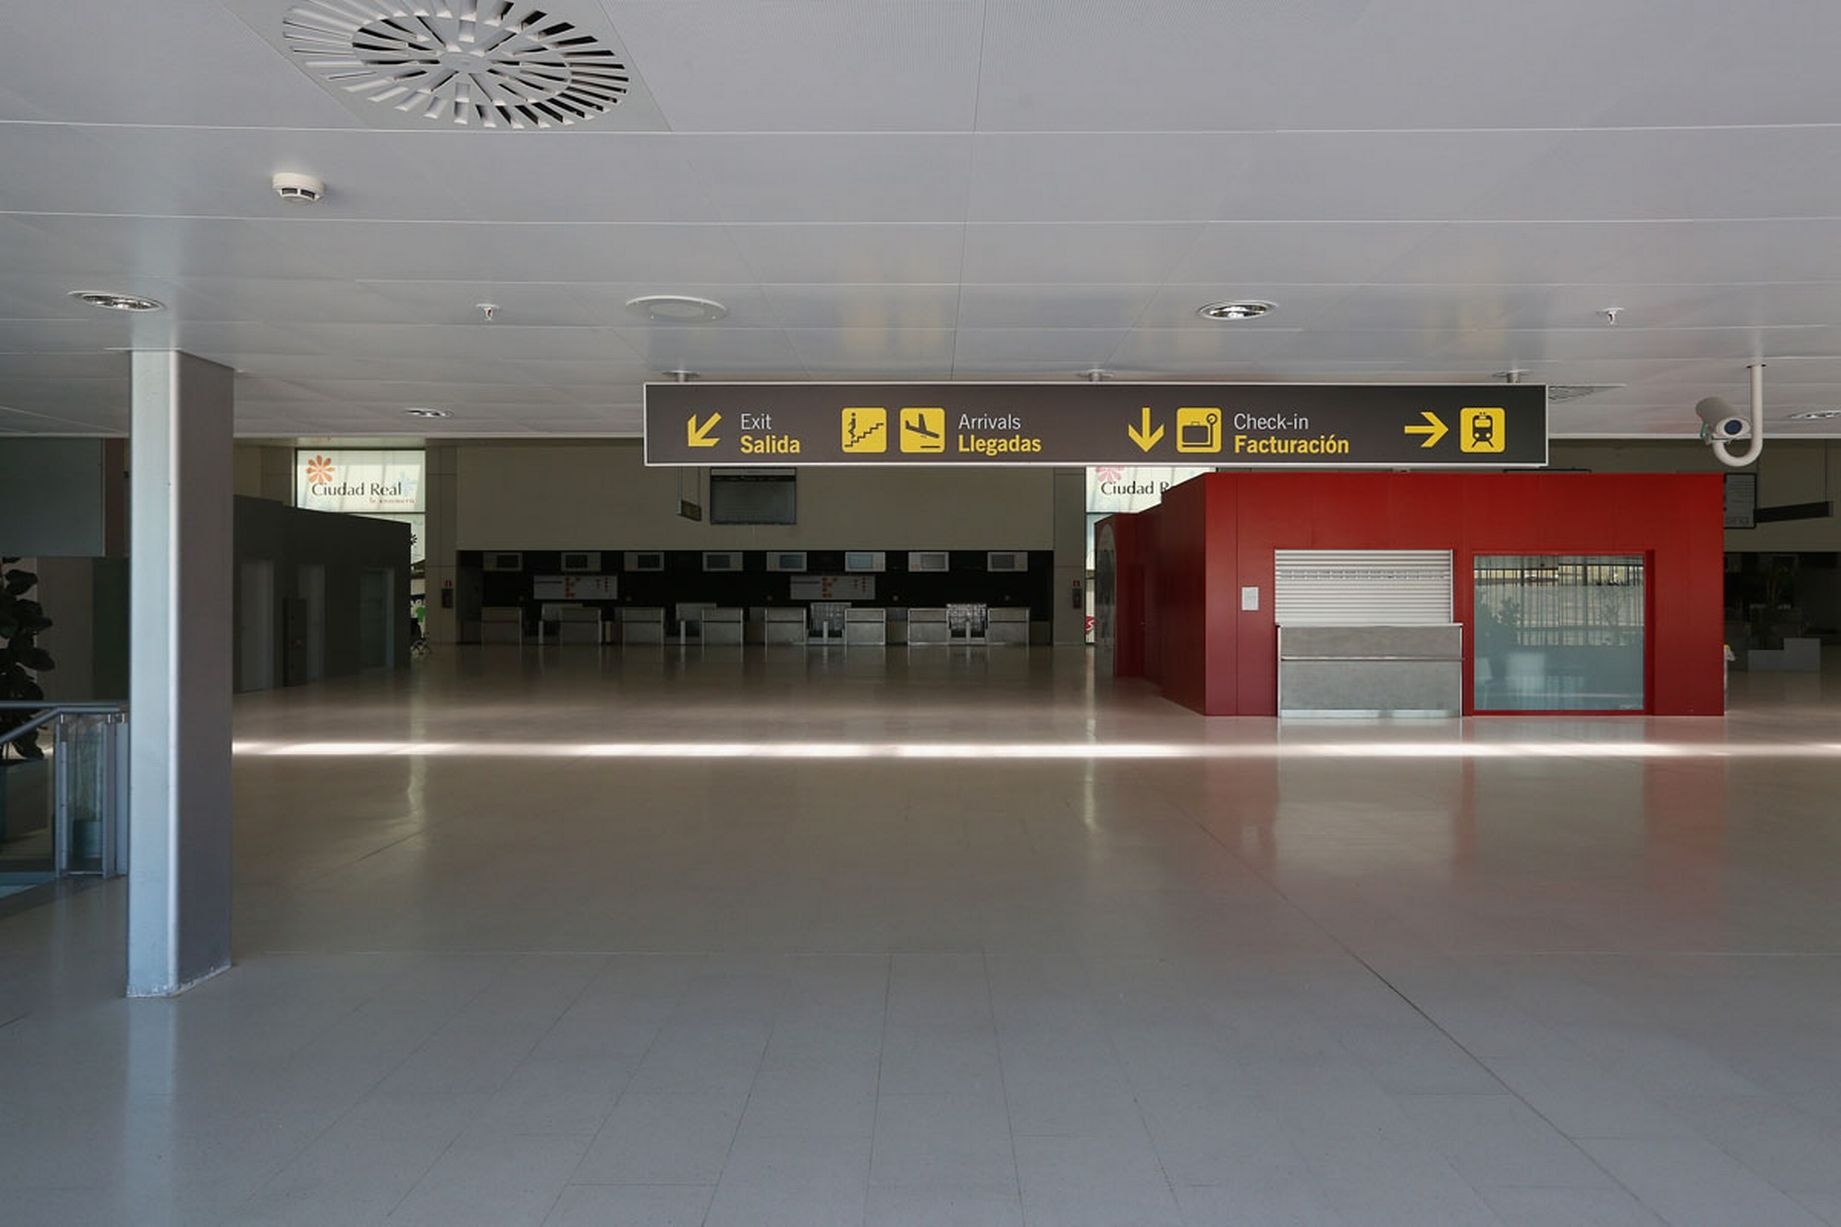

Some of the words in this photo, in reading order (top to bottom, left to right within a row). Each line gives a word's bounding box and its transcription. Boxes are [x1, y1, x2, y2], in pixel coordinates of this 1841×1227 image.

[740, 413, 772, 430] Exit
[958, 413, 1021, 430] Arrivals
[1233, 412, 1309, 430] Check-in
[740, 434, 801, 454] Salida
[958, 434, 1042, 457] Llegadas
[1233, 434, 1349, 454] Facturación
[312, 482, 365, 496] Ciudad
[370, 482, 402, 496] Real
[1101, 481, 1154, 495] Ciudad
